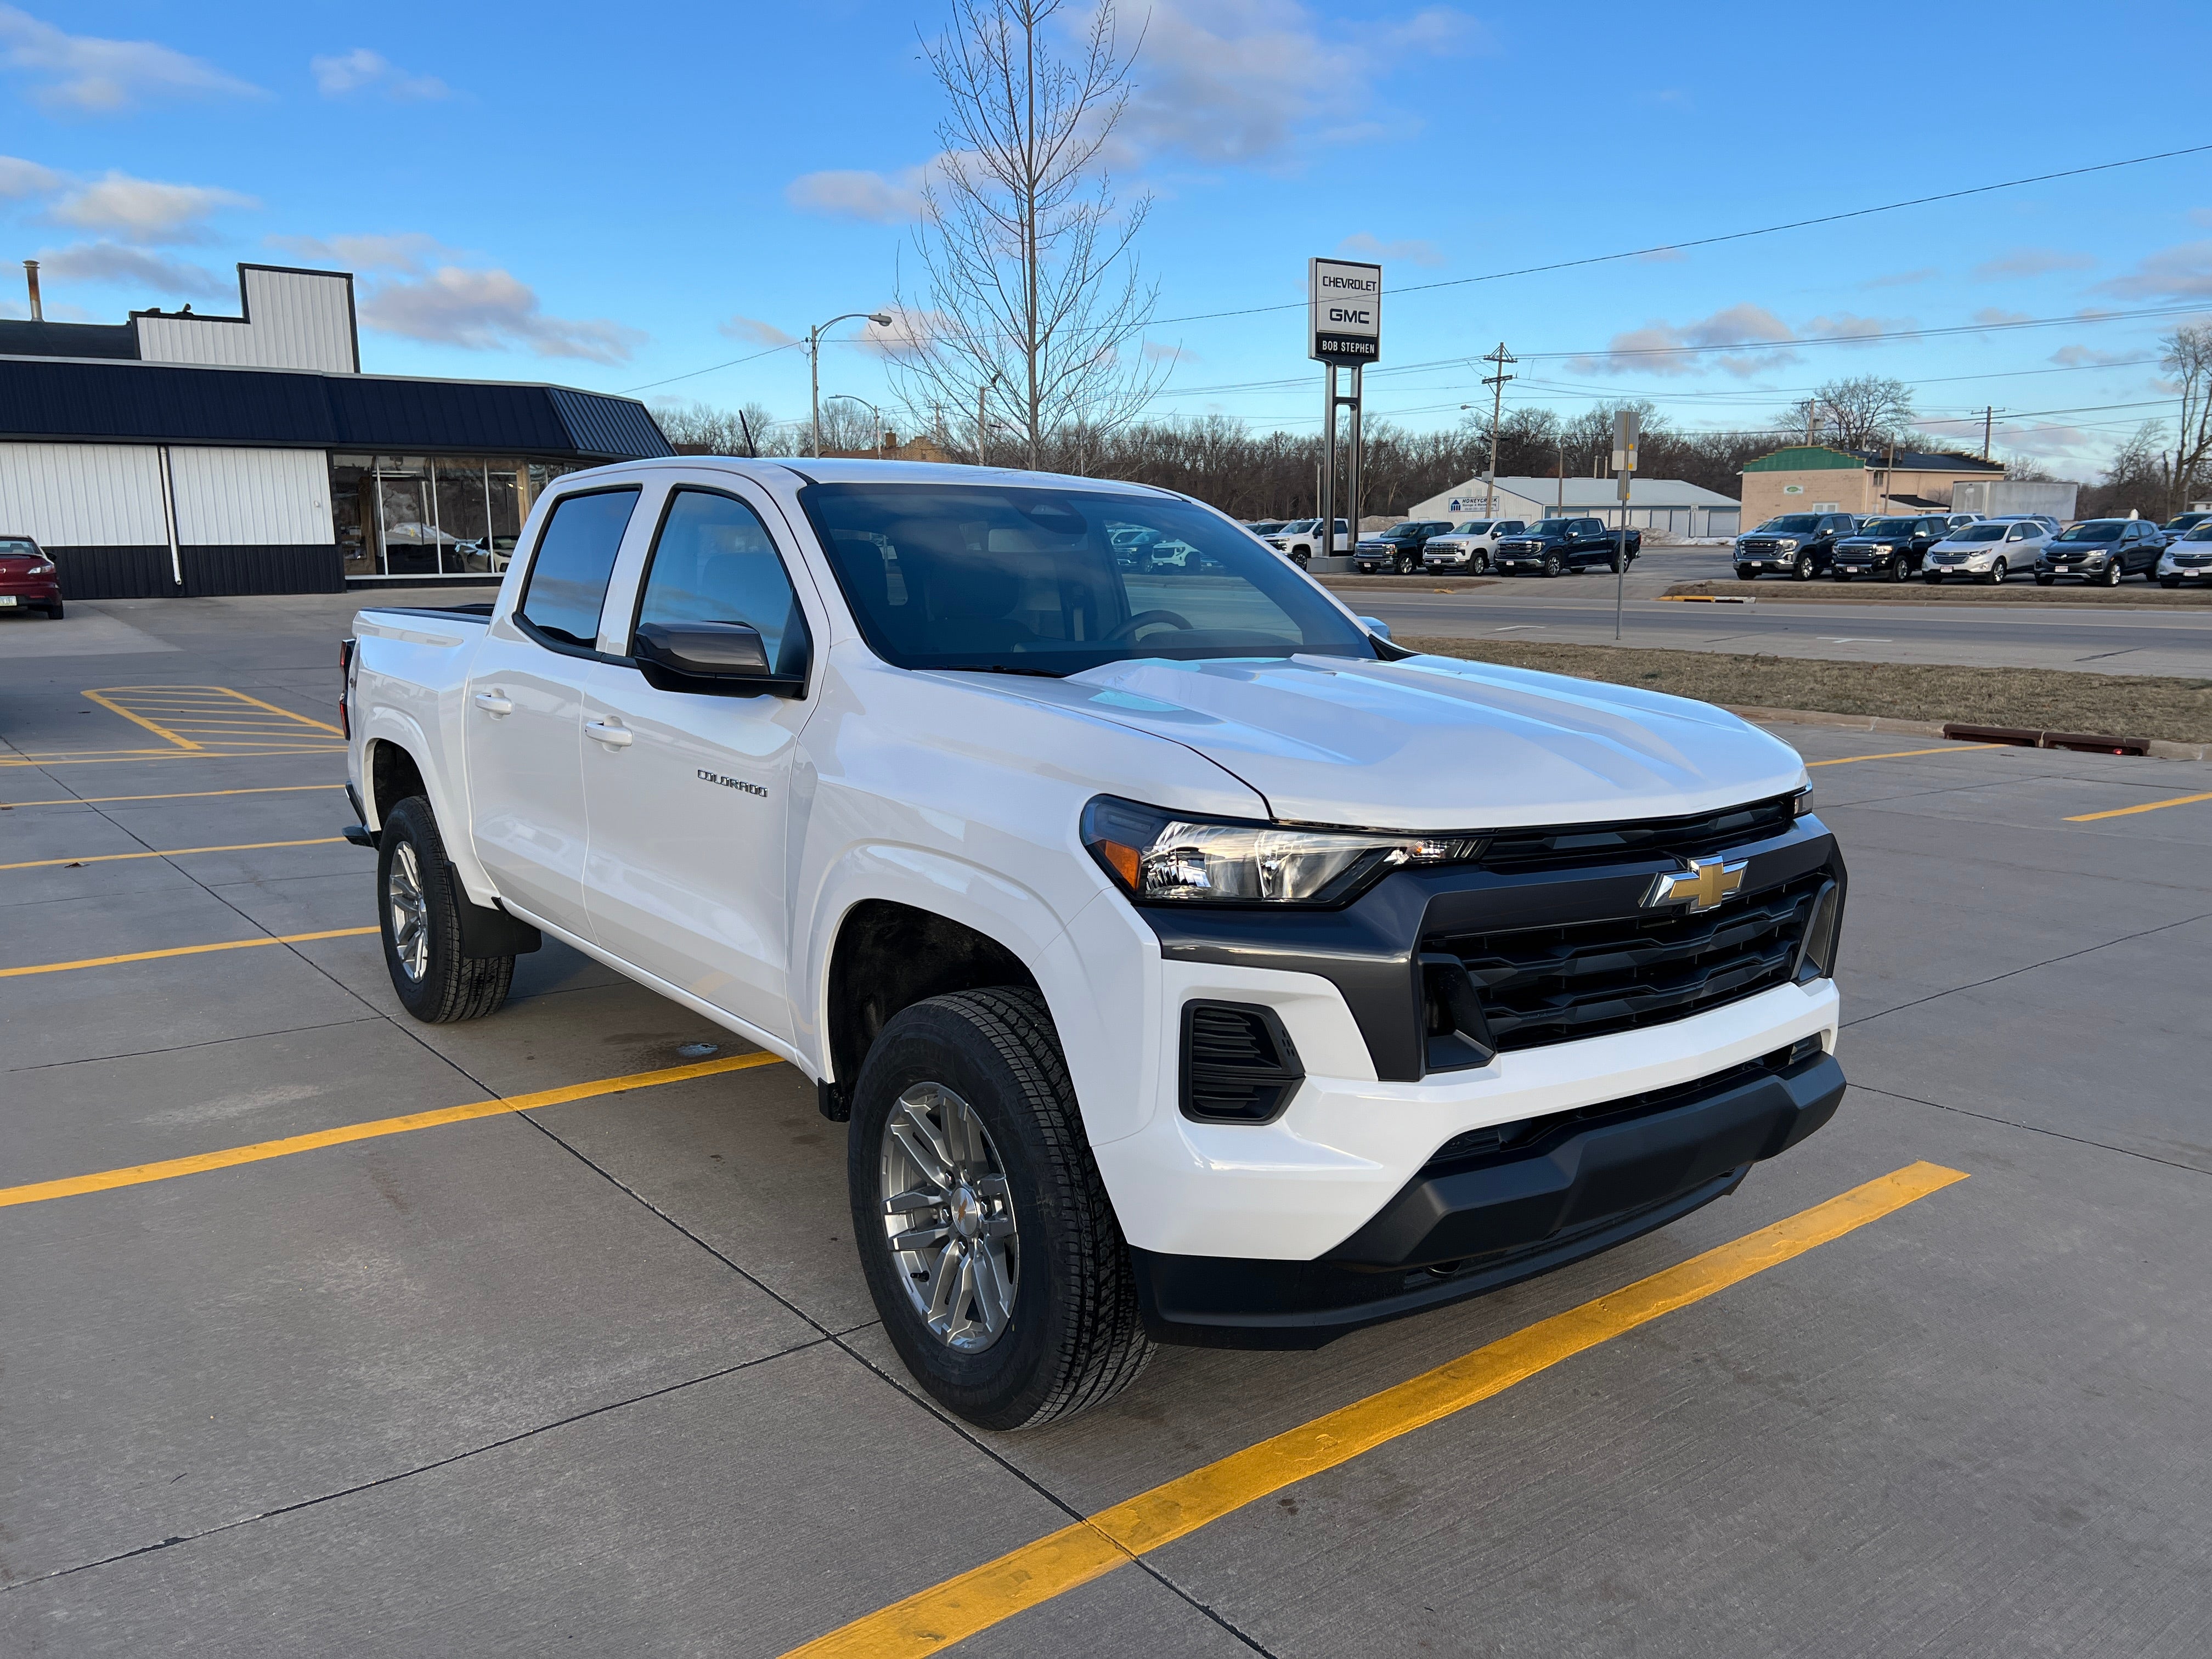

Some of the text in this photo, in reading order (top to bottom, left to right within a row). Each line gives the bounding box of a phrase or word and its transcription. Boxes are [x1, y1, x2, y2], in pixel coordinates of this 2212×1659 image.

[1323, 276, 1376, 291] CHEVROLET
[1330, 308, 1369, 324] GMC
[1322, 340, 1375, 354] BOB STEPHEN
[697, 769, 768, 797] COLORADO
